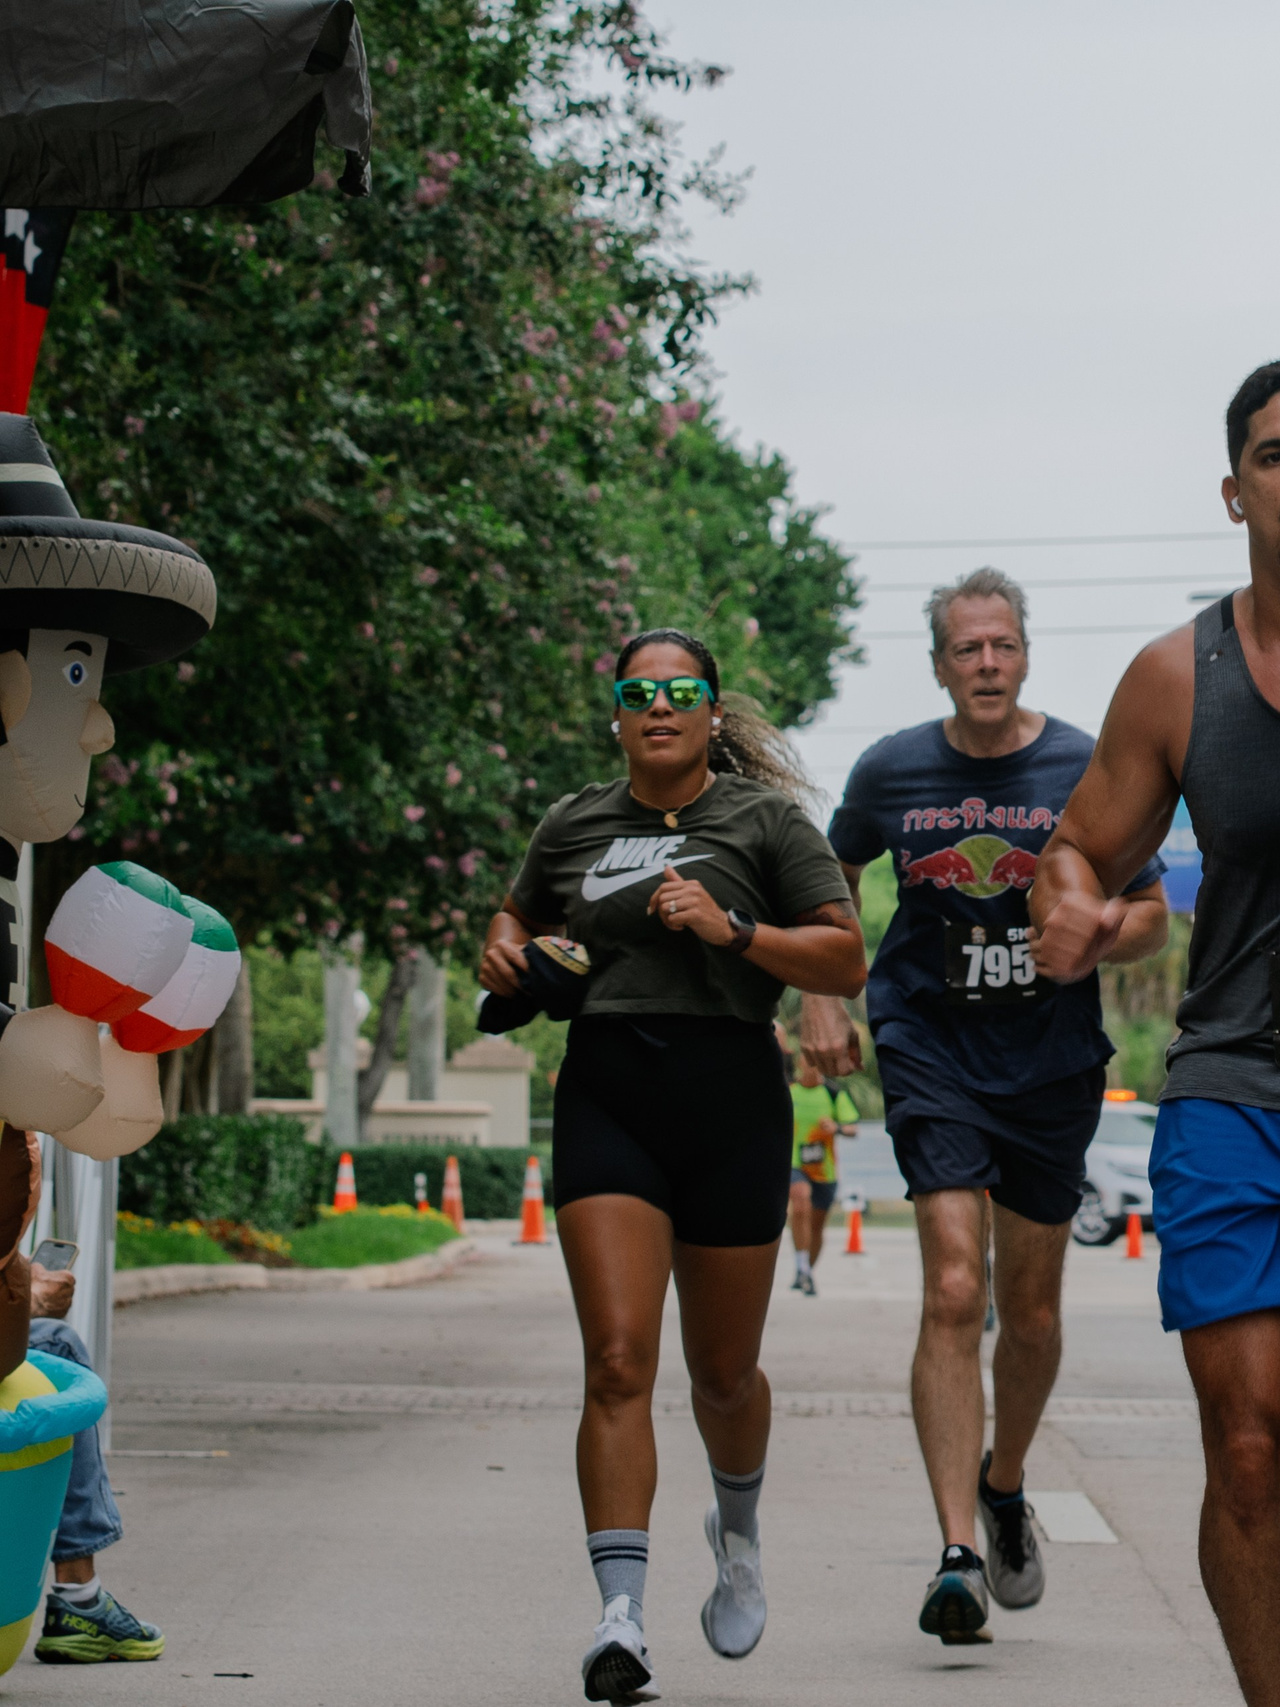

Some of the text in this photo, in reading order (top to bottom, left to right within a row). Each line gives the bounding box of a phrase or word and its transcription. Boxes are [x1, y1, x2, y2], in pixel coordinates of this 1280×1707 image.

[597, 835, 687, 872] NIKE
[961, 943, 1037, 988] 795
[61, 1612, 99, 1637] HOKA
